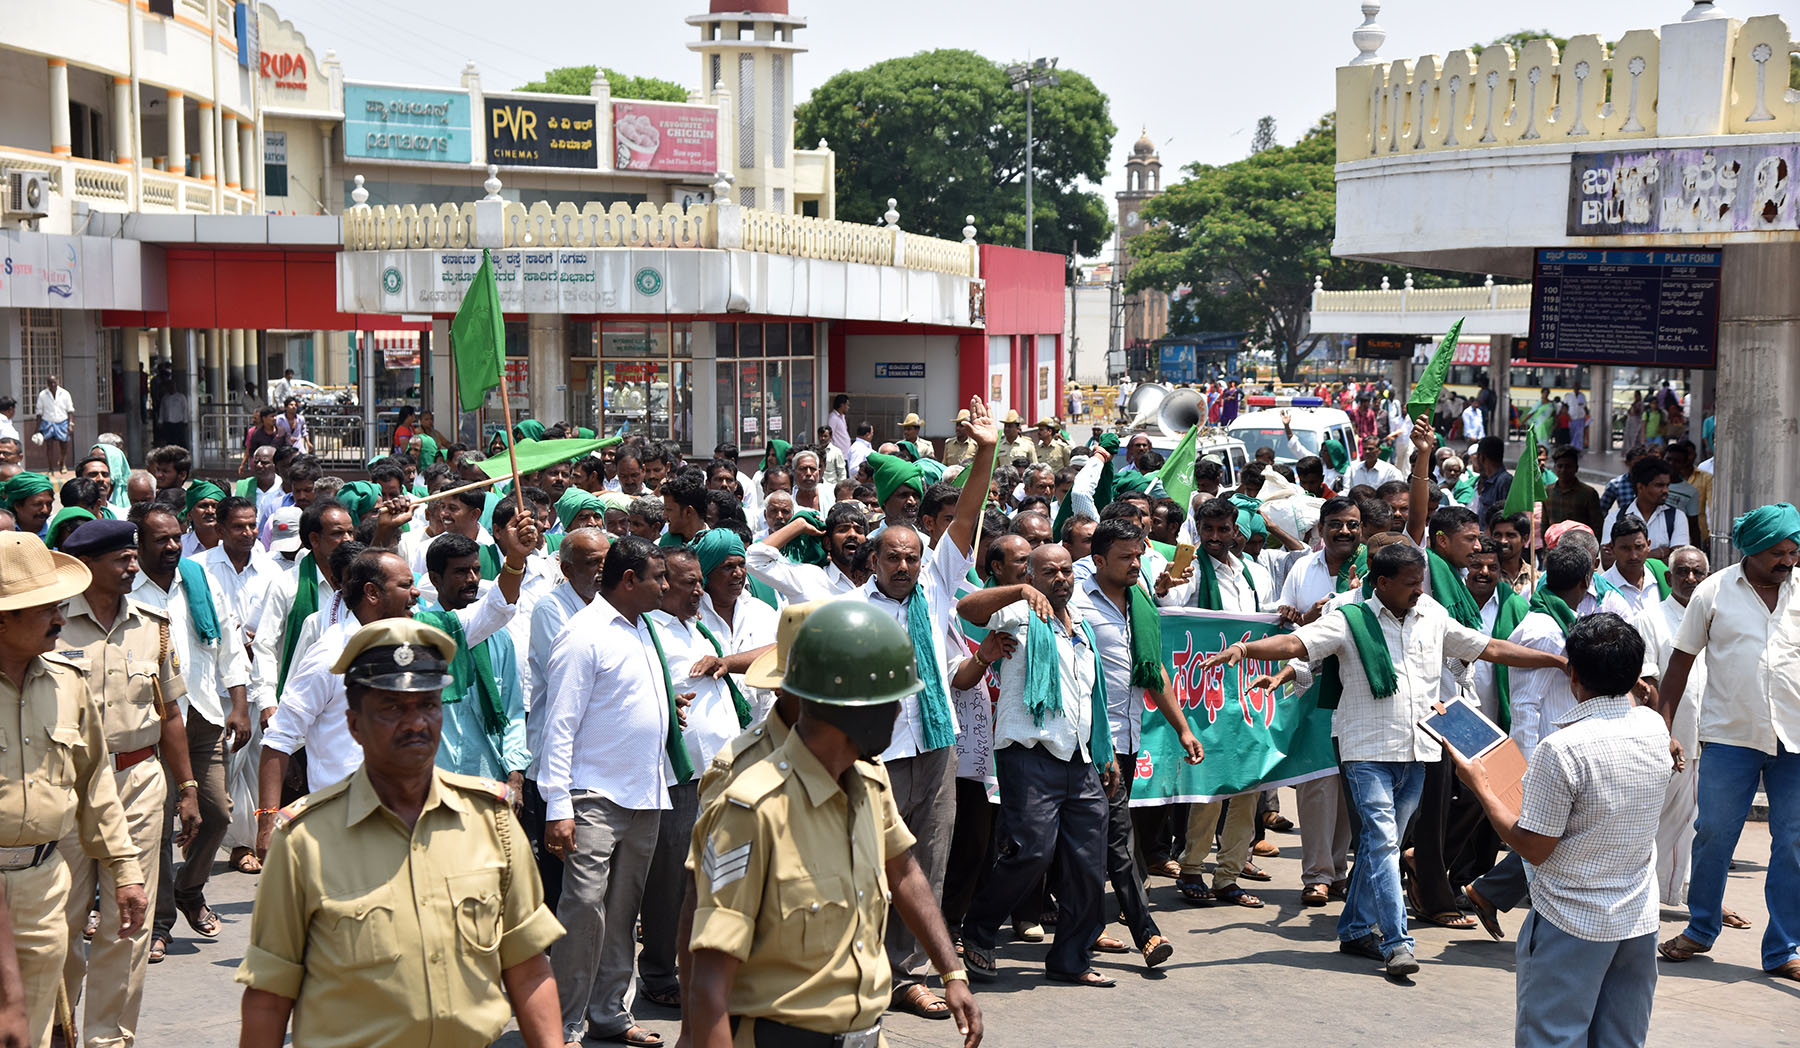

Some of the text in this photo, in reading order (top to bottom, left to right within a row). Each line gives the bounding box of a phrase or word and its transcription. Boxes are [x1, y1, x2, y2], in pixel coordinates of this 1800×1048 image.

[493, 105, 538, 142] PVR
[659, 121, 703, 129] FAVOURITE
[666, 128, 714, 139] CHICKEN
[366, 131, 449, 152] pantaloons
[493, 149, 539, 160] CINEMAS
[525, 252, 554, 264] ಸಾರಿಗೆ
[559, 253, 587, 264] ನಿಗಮ
[1601, 251, 1607, 263] 1
[1646, 252, 1715, 264] 1 PLAT FORM
[524, 269, 558, 281] ಸಾರಿಗೆ
[559, 271, 595, 284] ವಿಭಾಗ
[1543, 286, 1559, 294] 100
[1541, 323, 1556, 331] 116
[1659, 325, 1699, 335] Coorgally,
[1540, 332, 1555, 340] 119
[1540, 341, 1554, 349] 133
[1658, 343, 1687, 352] Infosys,
[616, 373, 658, 384] Enquiry
